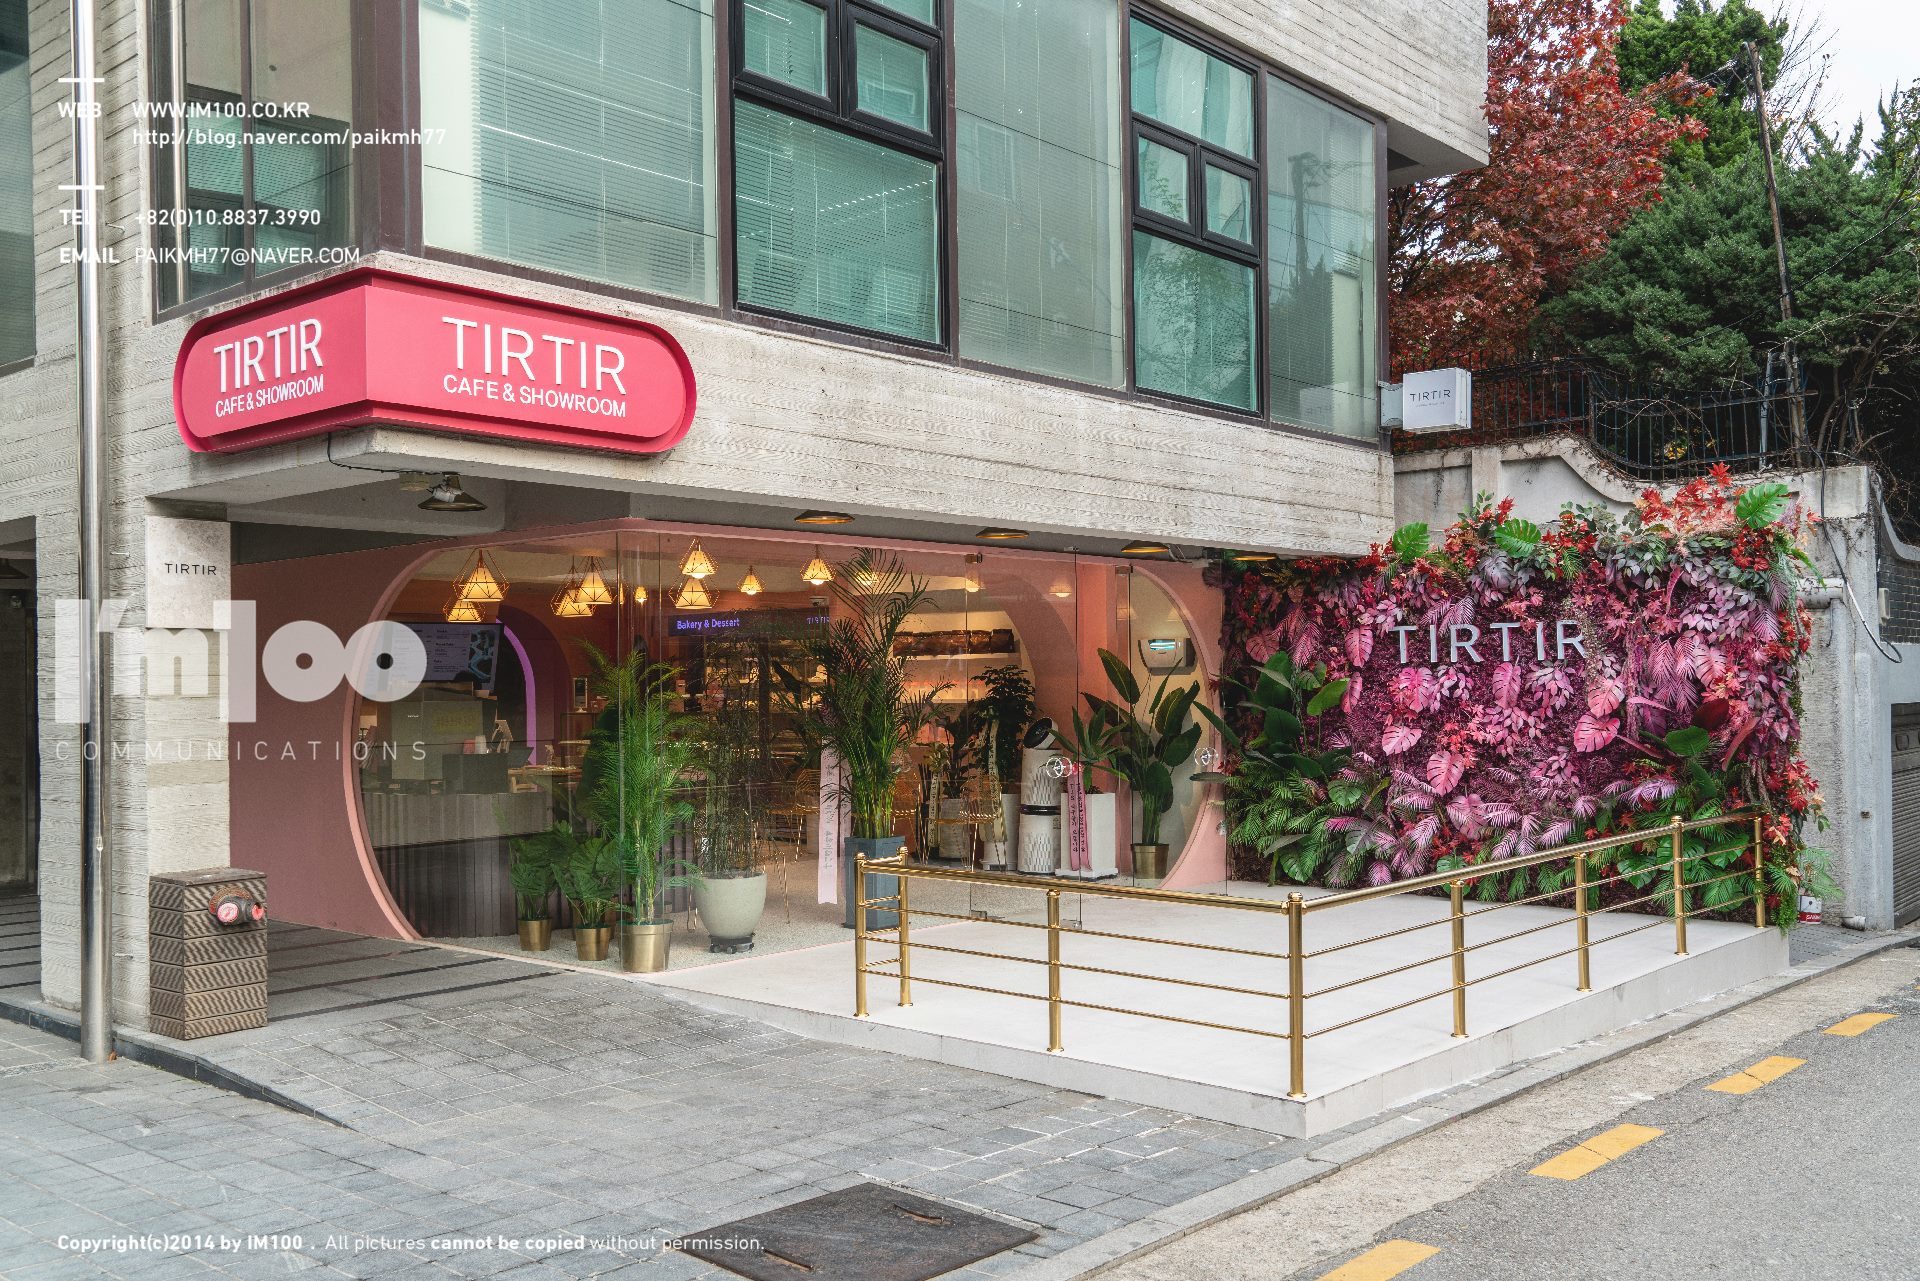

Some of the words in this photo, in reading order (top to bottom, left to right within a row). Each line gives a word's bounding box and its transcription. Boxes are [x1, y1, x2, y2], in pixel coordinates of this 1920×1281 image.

[213, 319, 324, 393] TIRTIR
[442, 316, 627, 395] TIRTIR
[215, 396, 245, 418] CAFE
[246, 394, 254, 411] &
[255, 374, 324, 409] SHOWROOM
[443, 374, 499, 400] CAFE
[502, 383, 515, 401] &
[519, 386, 626, 418] SHOWROOM
[1409, 389, 1451, 402] TIRTIR
[164, 562, 217, 576] TIRTIR
[676, 619, 703, 631] Bakery
[1391, 619, 1587, 664] TIRTIR
